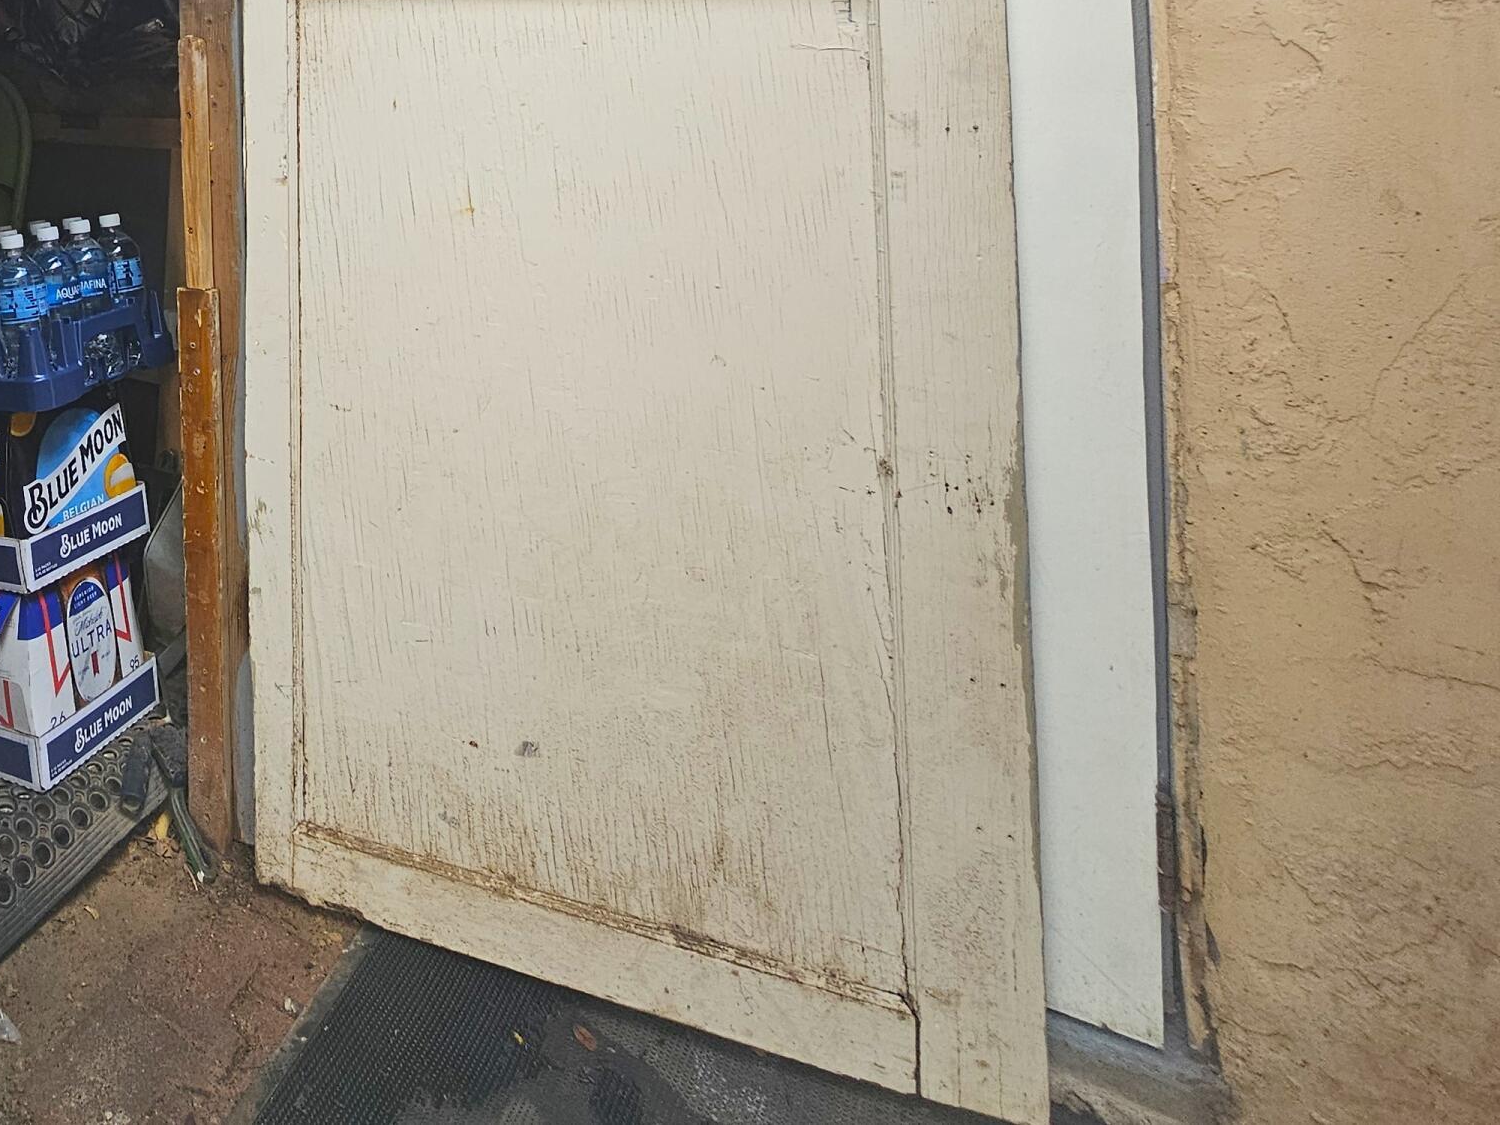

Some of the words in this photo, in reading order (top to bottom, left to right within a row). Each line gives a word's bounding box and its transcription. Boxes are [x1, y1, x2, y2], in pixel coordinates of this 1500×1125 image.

[55, 284, 80, 301] AQUA
[27, 456, 80, 530] BLUE
[78, 409, 125, 474] MOON
[62, 493, 106, 521] BELGIAN
[59, 530, 91, 559] BLUE
[91, 513, 123, 540] MOON
[71, 618, 113, 659] ULTRA
[74, 718, 104, 754] BLUE
[104, 695, 134, 728] MOON
